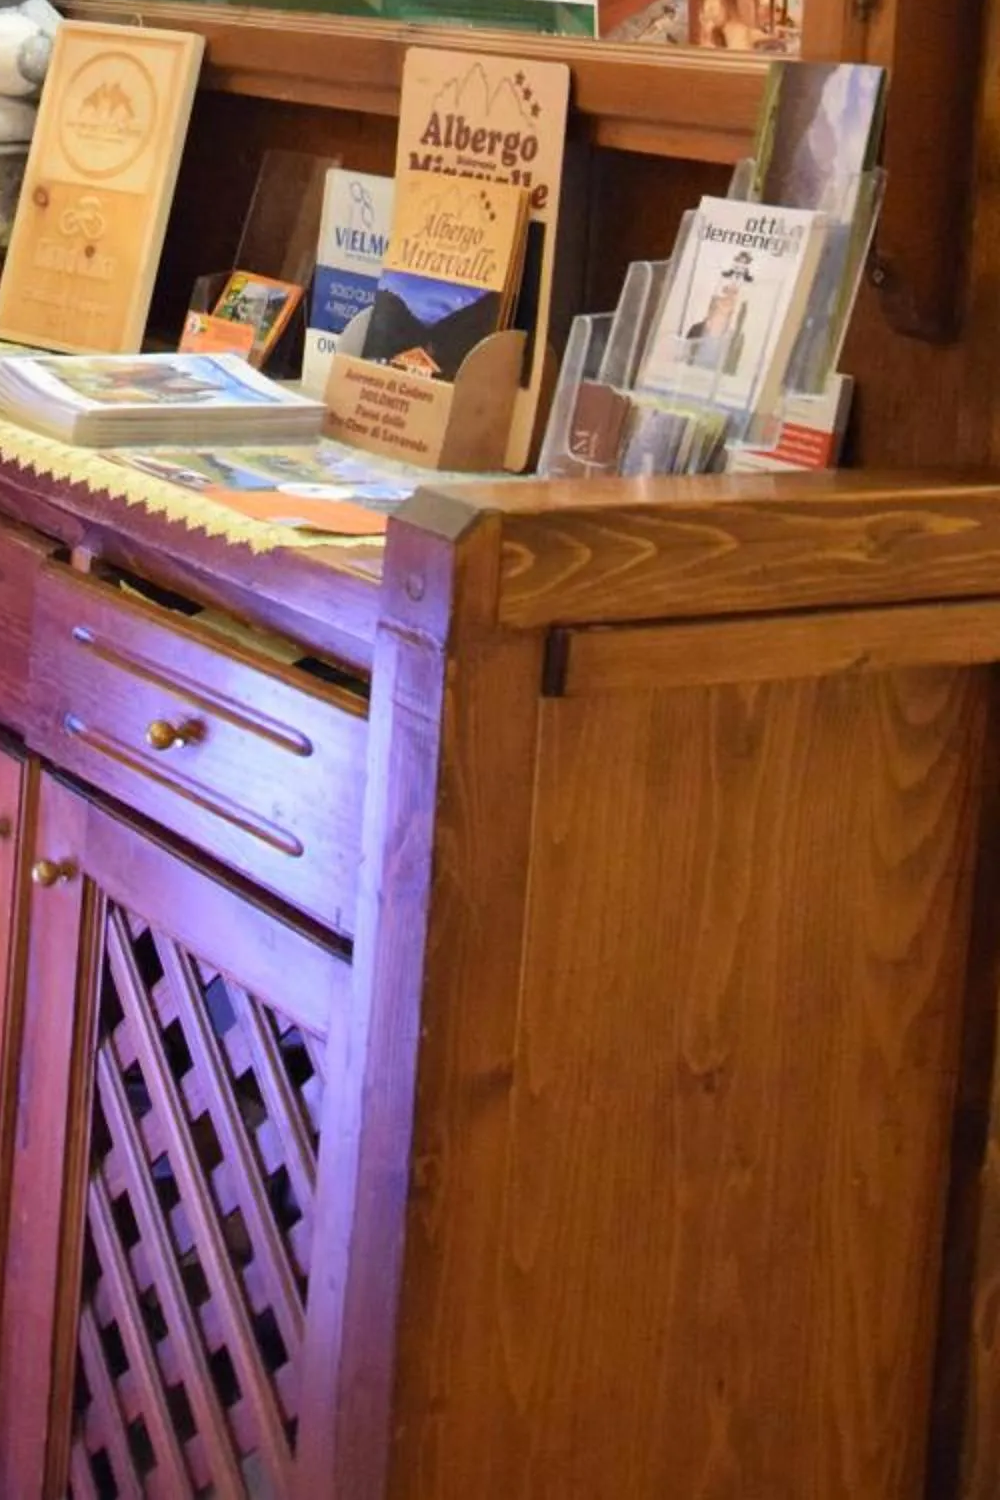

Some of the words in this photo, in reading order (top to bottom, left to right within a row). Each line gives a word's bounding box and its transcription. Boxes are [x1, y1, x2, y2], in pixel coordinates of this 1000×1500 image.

[420, 110, 539, 167] Albergo
[413, 212, 485, 253] Albergo
[401, 238, 498, 284] Miravalle
